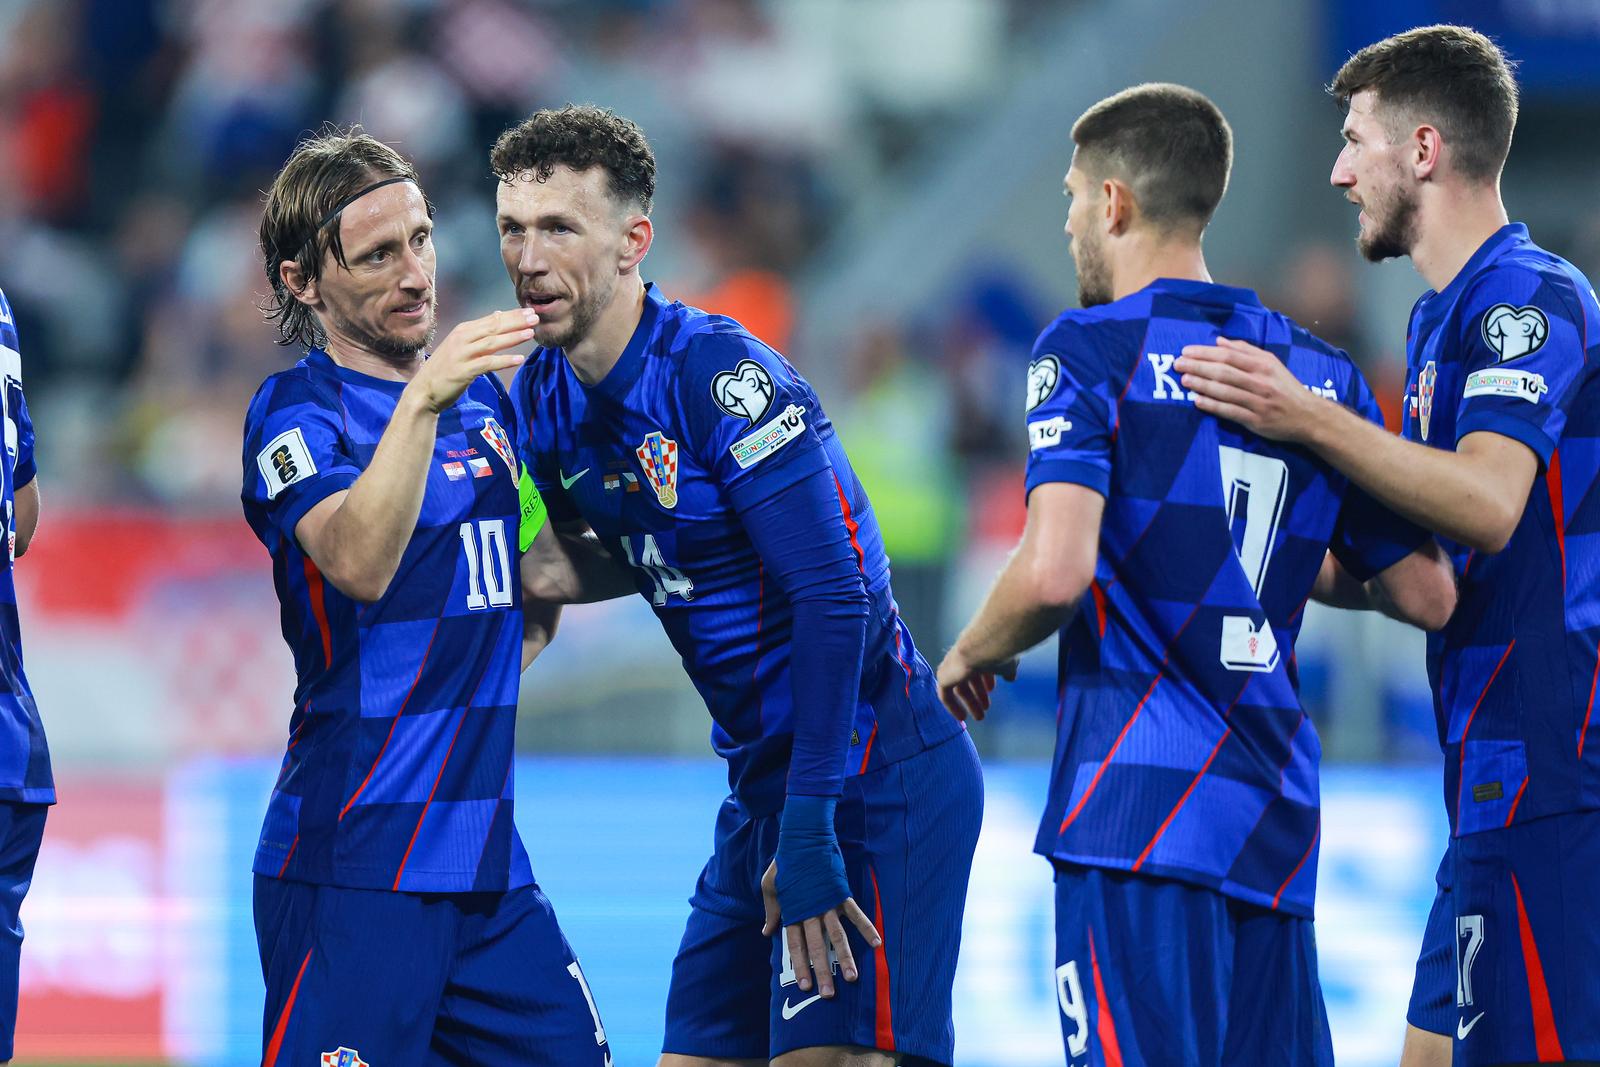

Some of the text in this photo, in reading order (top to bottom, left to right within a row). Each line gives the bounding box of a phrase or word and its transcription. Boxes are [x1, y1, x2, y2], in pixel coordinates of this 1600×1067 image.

[1521, 377, 1540, 394] 10
[780, 414, 800, 432] 10
[1040, 427, 1058, 439] 10
[735, 427, 784, 460] FOUNDATION
[460, 519, 513, 611] 10
[620, 534, 695, 607] 14
[1055, 959, 1089, 1058] 9
